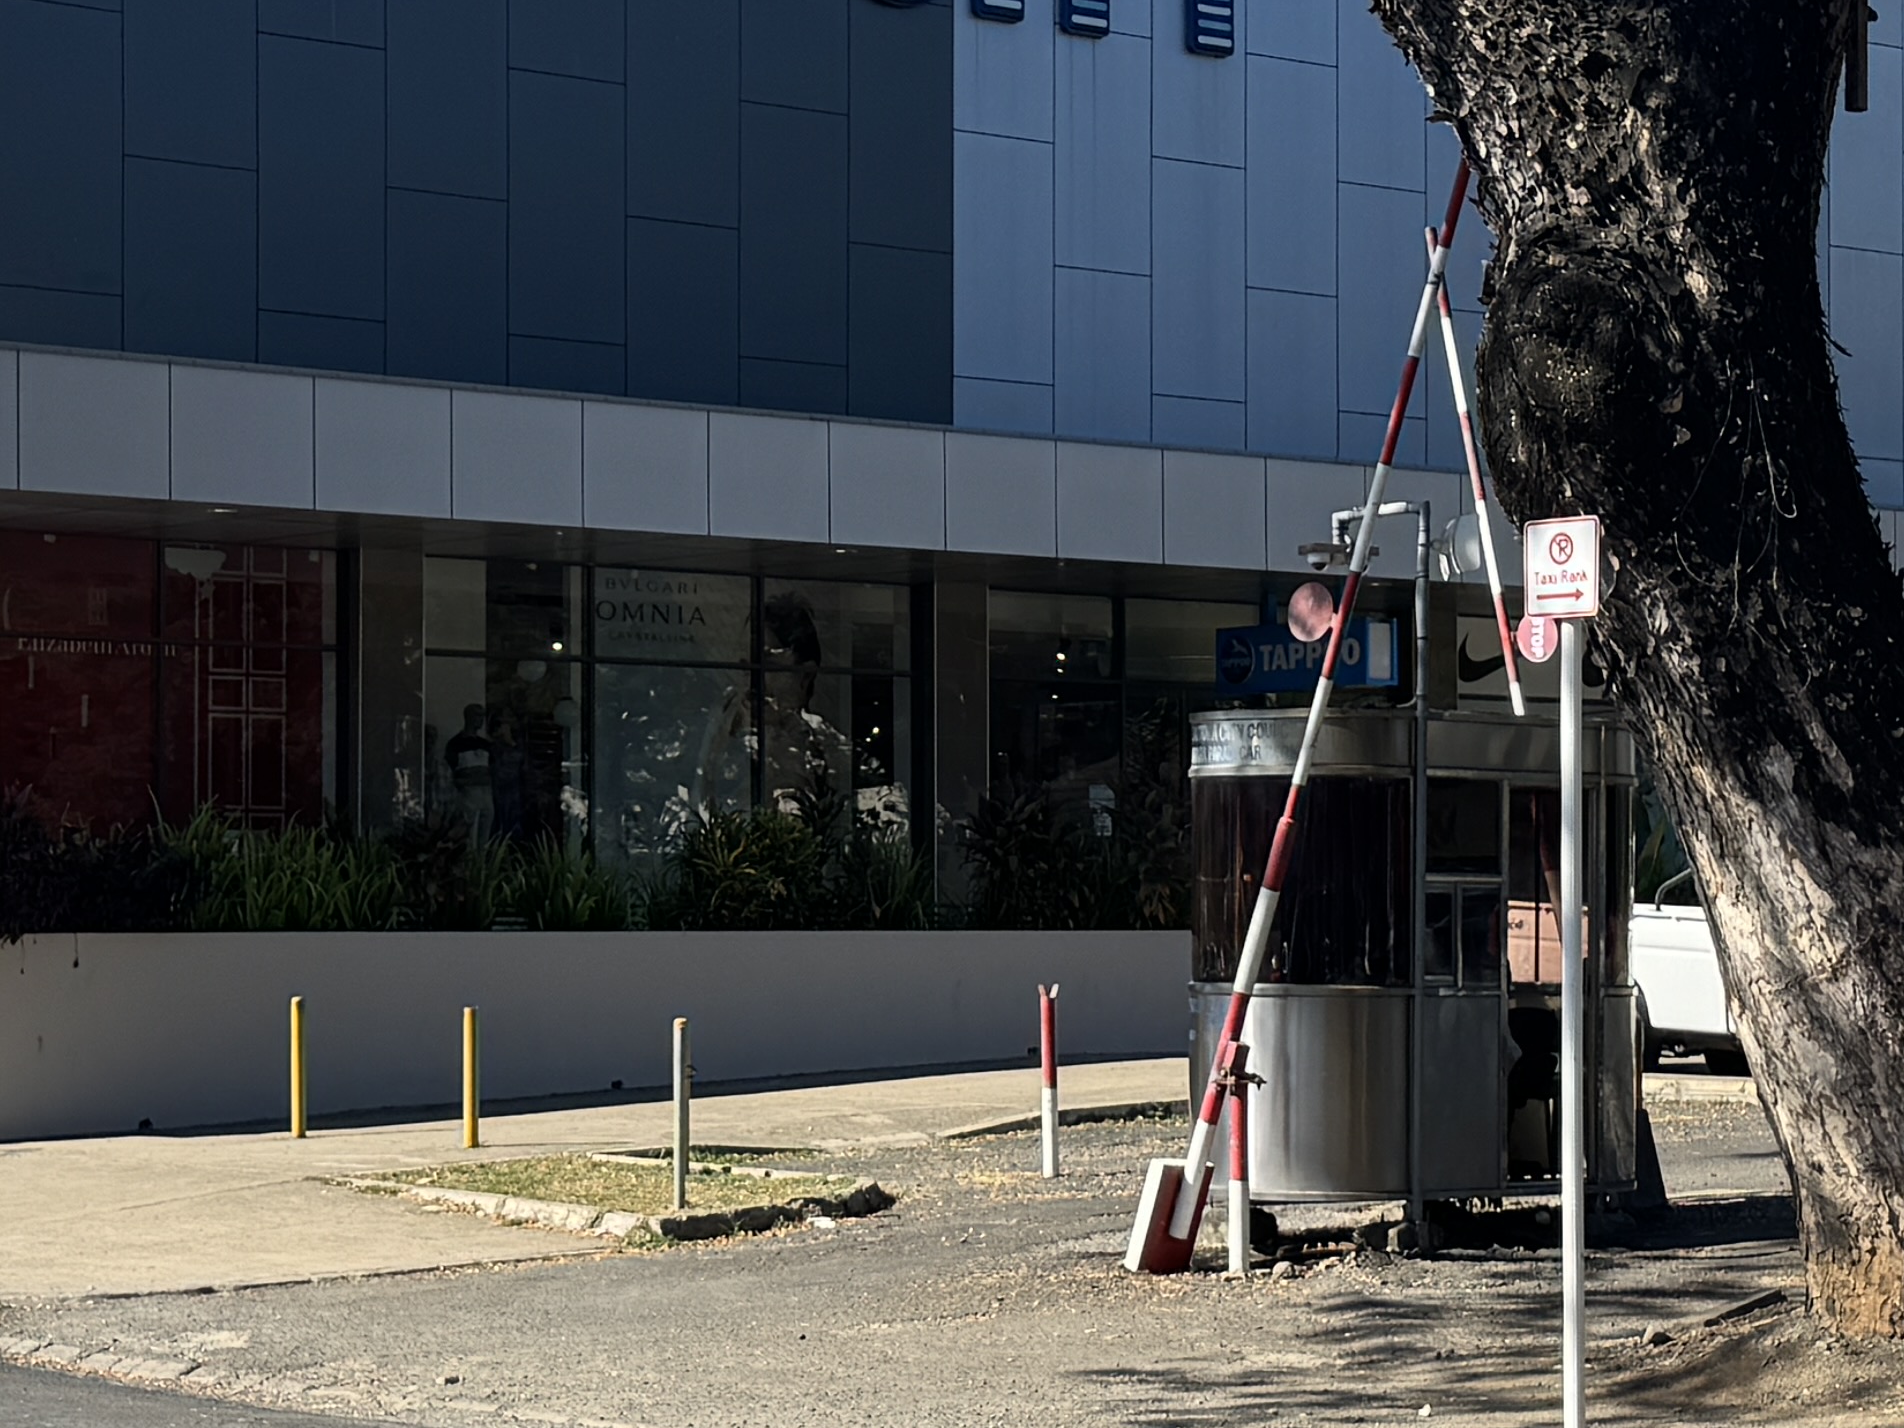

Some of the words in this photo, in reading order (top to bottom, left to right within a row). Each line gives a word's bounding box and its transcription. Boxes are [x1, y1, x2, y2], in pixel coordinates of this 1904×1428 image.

[1535, 572, 1557, 585] Taxi
[1561, 569, 1588, 584] Rank
[596, 600, 706, 626] OMNIA
[1259, 638, 1361, 671] TAPPO
